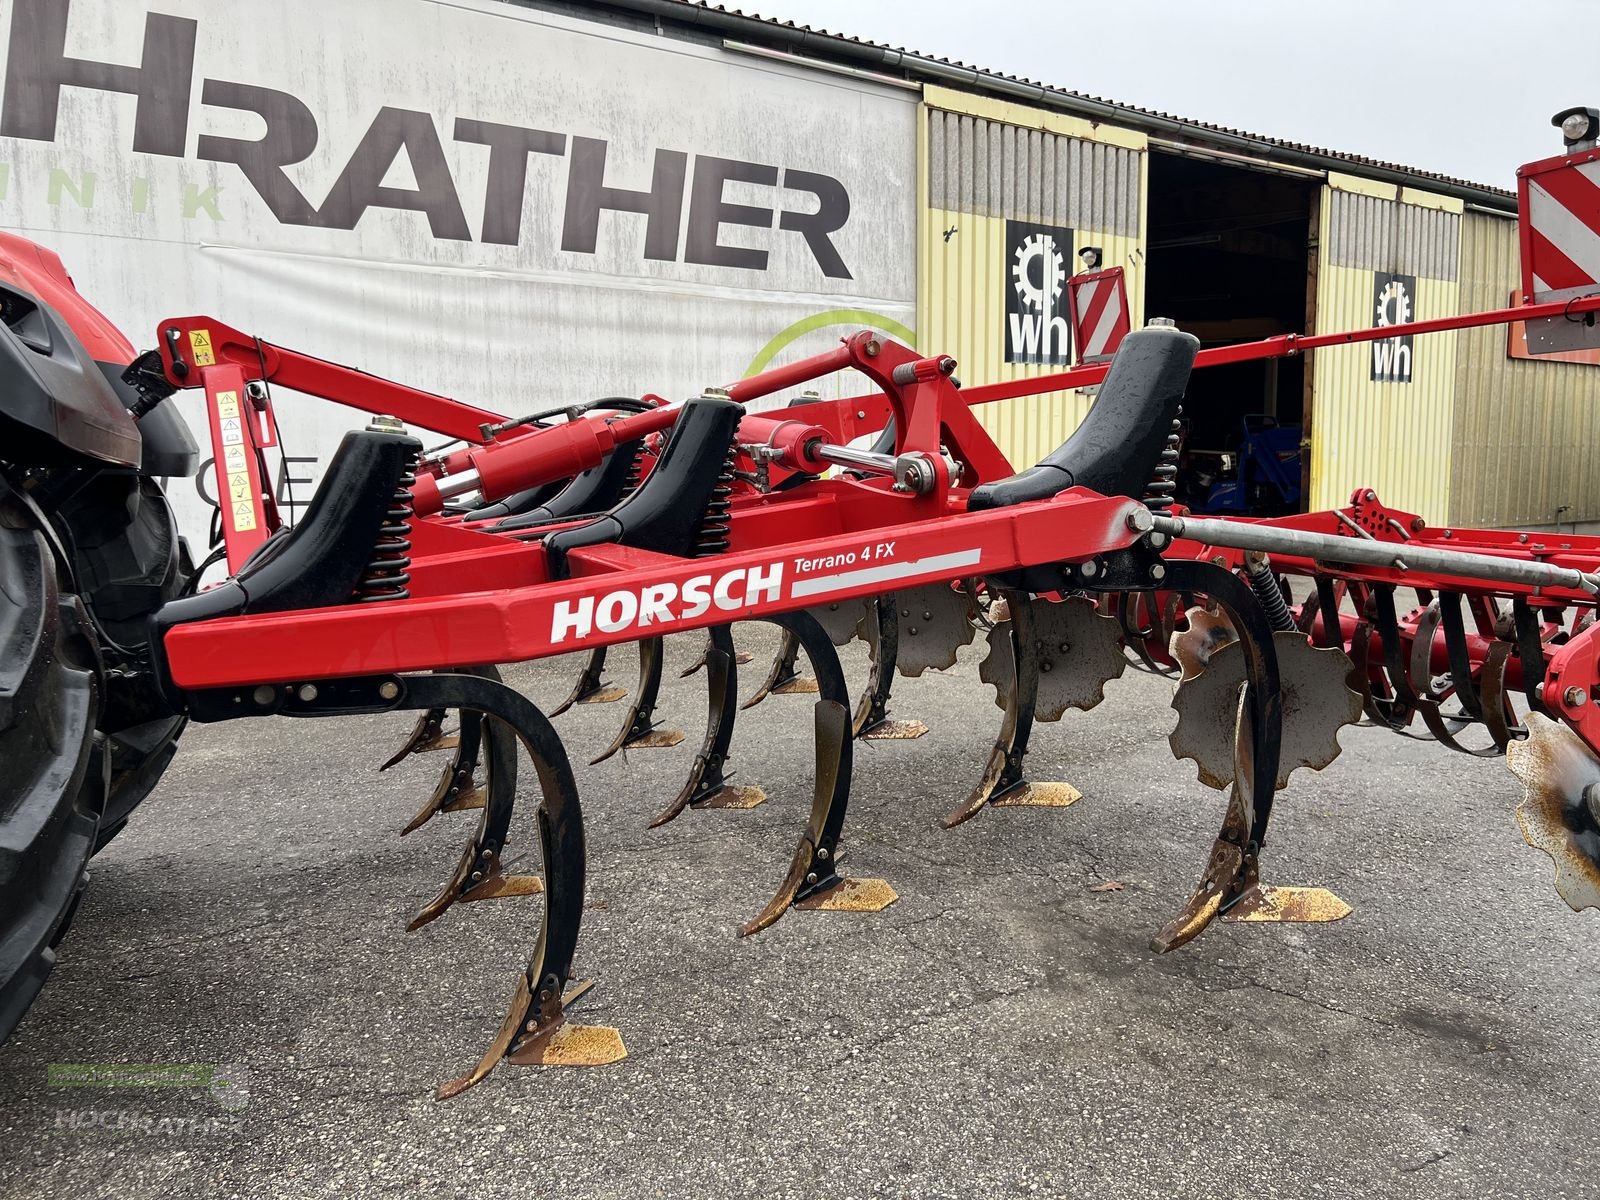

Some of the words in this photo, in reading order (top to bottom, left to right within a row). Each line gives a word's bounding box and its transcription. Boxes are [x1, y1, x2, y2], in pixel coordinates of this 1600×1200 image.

[794, 551, 856, 574] Terrano
[860, 546, 871, 561] 4
[875, 541, 896, 559] FX
[550, 562, 785, 644] HORSCH
